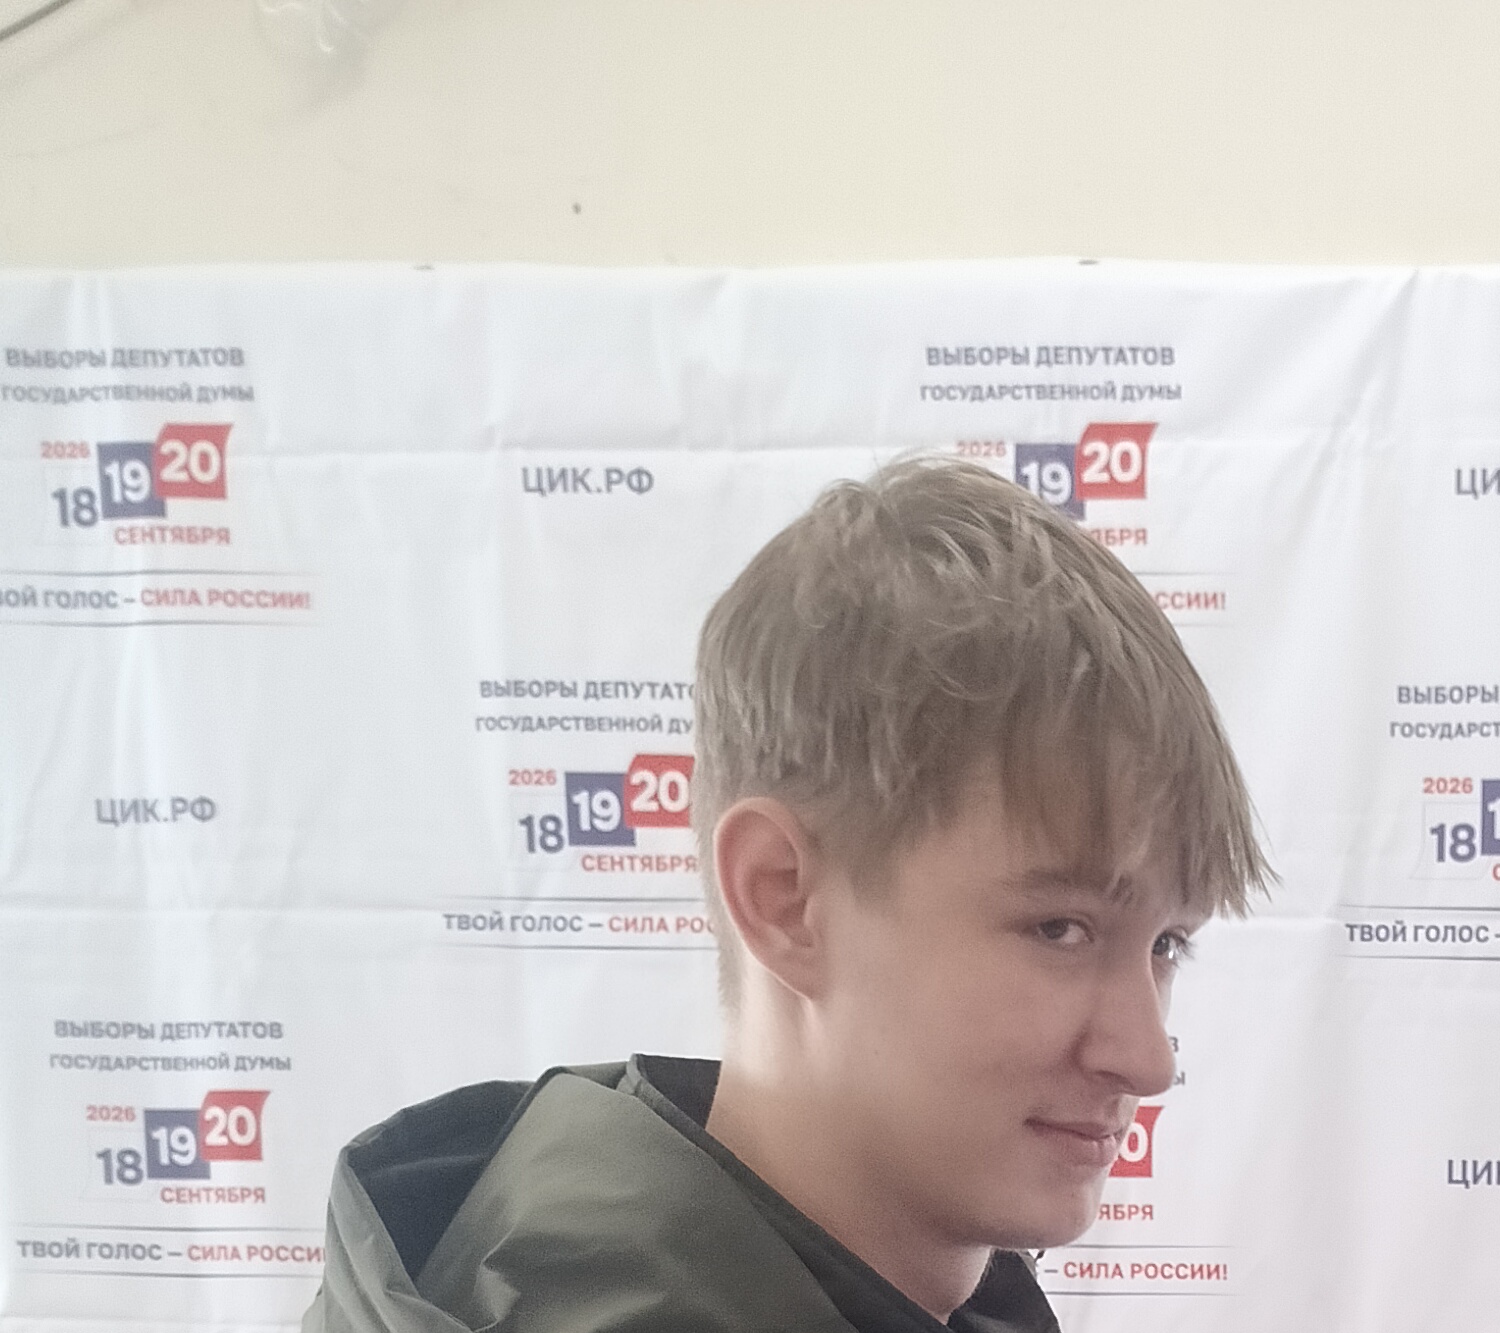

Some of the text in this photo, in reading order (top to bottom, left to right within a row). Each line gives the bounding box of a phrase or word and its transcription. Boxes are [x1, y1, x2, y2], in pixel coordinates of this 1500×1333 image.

[6, 347, 244, 369] ВЫБОРЫ ДЕПУТАТОВ
[926, 346, 1175, 367] ВЫБОРЫ ДЕПУТАТОВ
[2, 383, 255, 404] ГОСУДАРСТВЕННОЙ ДУМЫ
[921, 381, 1182, 402] ГОСУДАРСТВЕННОЙ ДУМЫ
[41, 441, 90, 459] 2026
[957, 441, 1006, 457] 2026
[51, 439, 221, 528] 18 19 20
[522, 467, 653, 497] ЦИК.РФ
[1020, 442, 1142, 506] 19 20
[114, 526, 231, 545] СЕНТЯБРЯ
[1089, 528, 1148, 545] ЯБРЯ
[0, 585, 37, 609] ОЙ
[43, 589, 119, 609] ГОЛОС
[141, 587, 201, 608] СИЛА
[206, 589, 311, 610] РОССИИ!
[1155, 592, 1225, 610] ССИИ!
[480, 681, 695, 700] ВЫБОРЫ ДЕПУТАТ
[1398, 685, 1498, 704] ВЫБОРЫ
[476, 714, 693, 734] ГОСУДАРСТВЕННОЙ ДУ
[509, 770, 557, 786] 2026
[1423, 777, 1473, 794] 2026
[96, 796, 217, 825] ЦИК.РФ
[519, 770, 689, 853] 18 19 20
[1430, 824, 1476, 863] 18
[581, 855, 698, 873] СЕНТЯБРЯ
[443, 911, 504, 932] ТВОЙ
[510, 915, 583, 933] ГОЛОС
[609, 917, 669, 933] СИЛА
[1346, 921, 1407, 943] ТВОЙ
[1413, 924, 1489, 943] ГОЛОС
[54, 1020, 284, 1041] ВЫБОРЫ ДЕПУТАТОВ
[50, 1052, 291, 1072] ГОСУДАРСТВЕННОЙ ДУМЫ
[86, 1105, 136, 1122] 2026
[97, 1106, 256, 1185] 18 19 20
[1120, 1122, 1149, 1162] 0
[160, 1187, 266, 1204] СЕНТЯБРЯ
[1100, 1204, 1154, 1220] ЯБРЯ
[16, 1238, 80, 1260] ТВОЙ
[86, 1243, 162, 1261] ГОЛОС
[187, 1244, 241, 1262] СИЛА
[247, 1245, 325, 1262] РОССИ
[1063, 1262, 1124, 1279] СИЛА
[1131, 1264, 1228, 1280] РОССИИ!
